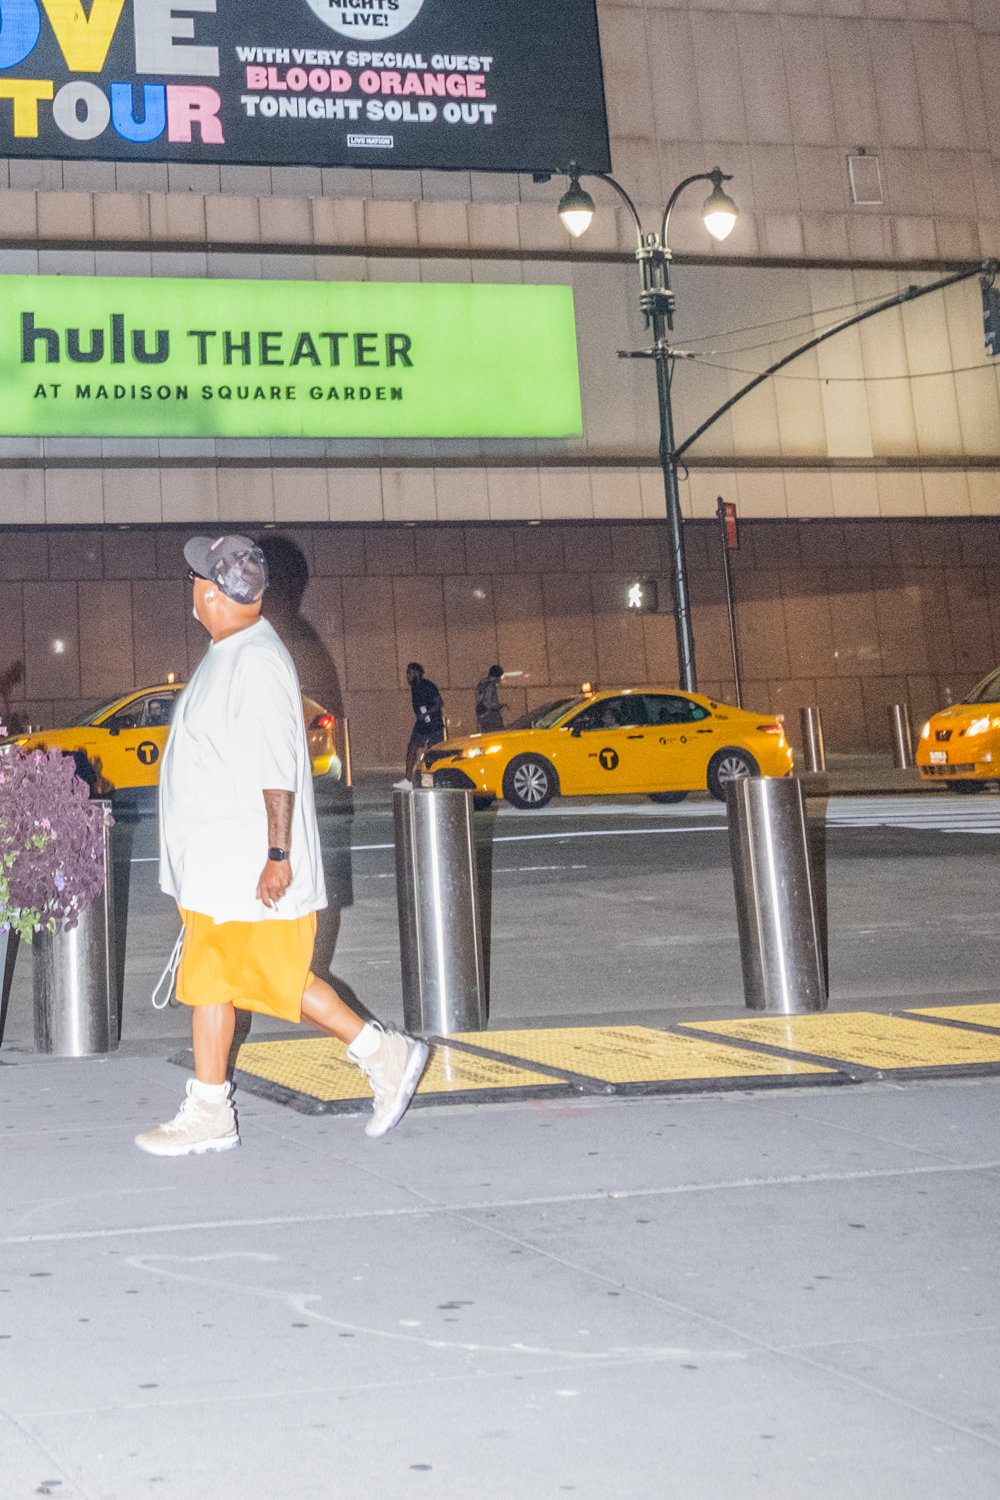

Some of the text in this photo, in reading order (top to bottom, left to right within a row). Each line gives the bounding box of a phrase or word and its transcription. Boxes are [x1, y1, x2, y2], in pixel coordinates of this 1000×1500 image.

[341, 12, 389, 27] LIVE!
[236, 46, 493, 72] WITH VERY SPECIAL GUEST
[246, 66, 487, 98] BLOOD ORANGE
[241, 95, 497, 125] TONIGHT SOLD OUT
[20, 312, 414, 367] hulu THEATER
[34, 384, 403, 401] AT MADISON SQUARE GARDEN
